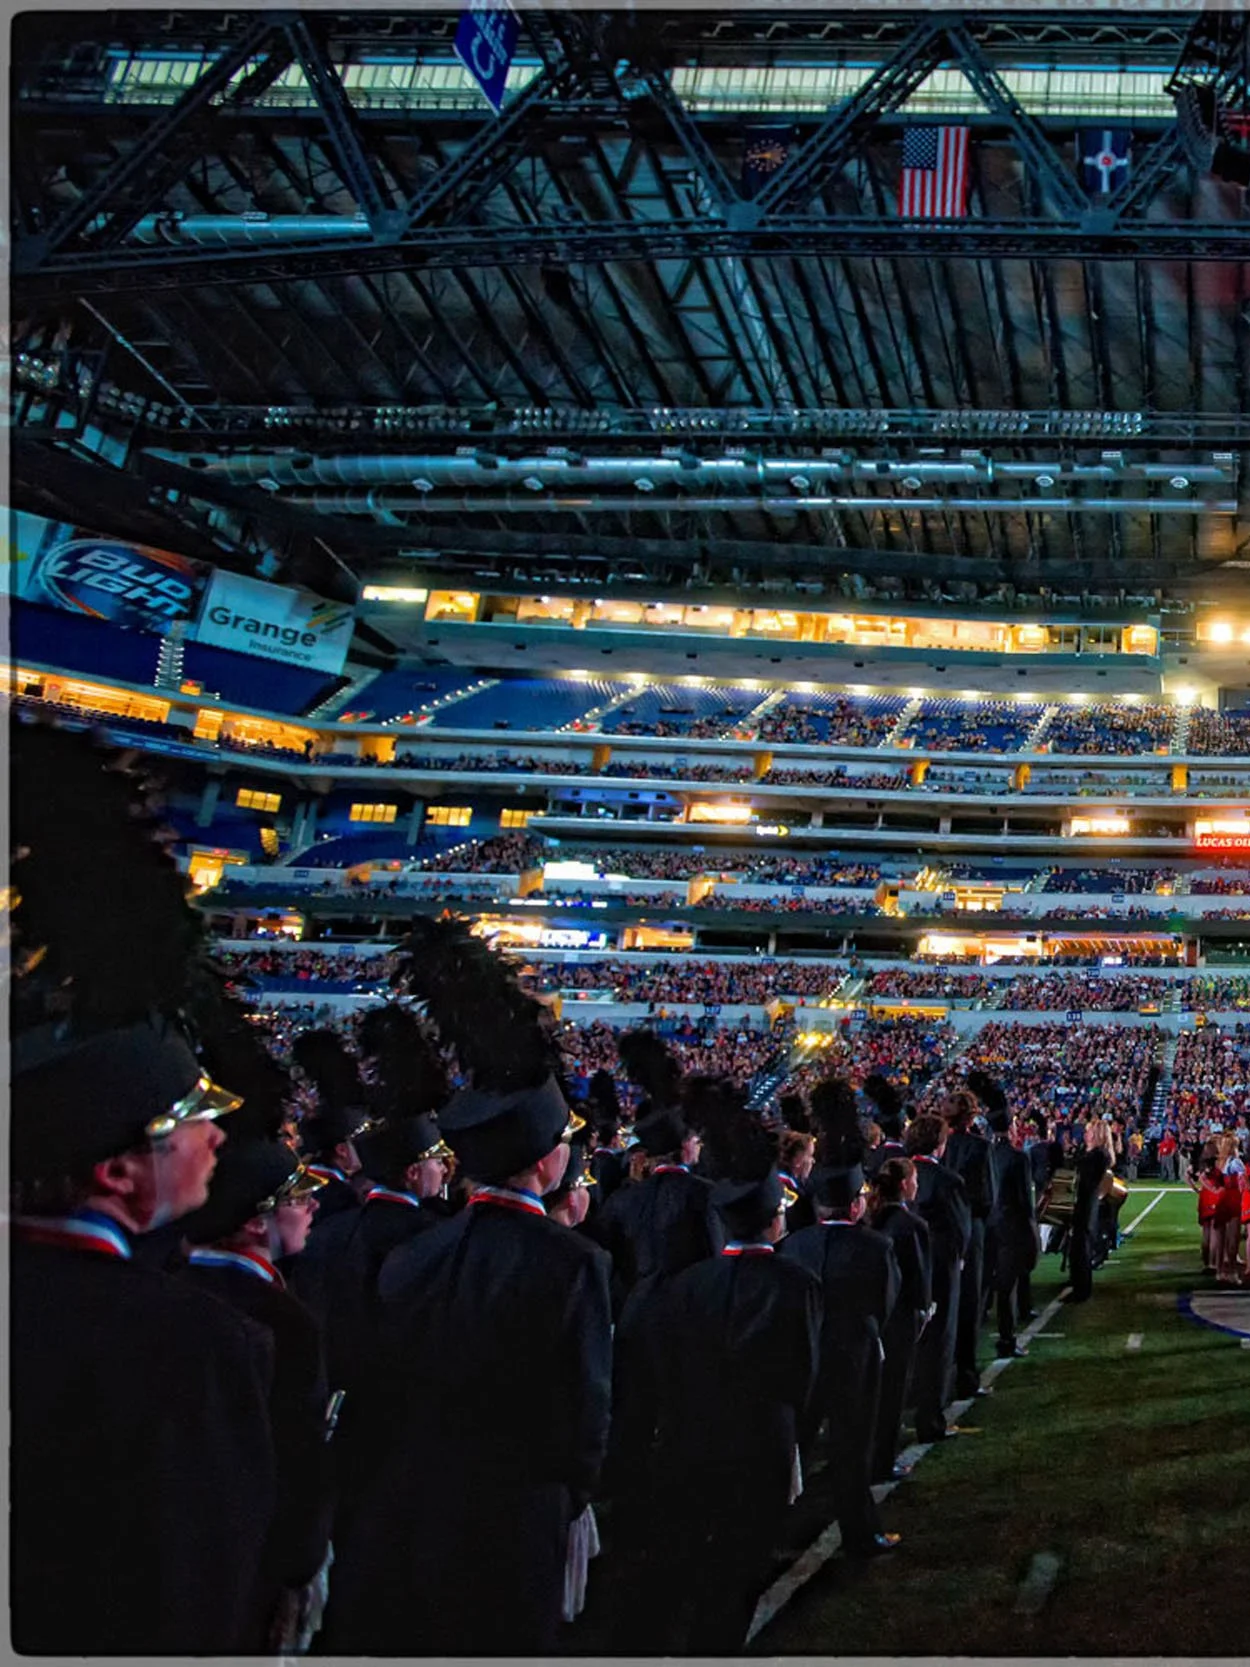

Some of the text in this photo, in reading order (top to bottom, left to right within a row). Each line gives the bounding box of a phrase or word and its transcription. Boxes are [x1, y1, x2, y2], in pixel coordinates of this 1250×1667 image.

[46, 561, 189, 616] LIGHT
[77, 549, 192, 600] BUD
[208, 605, 317, 647] Grange
[248, 639, 312, 662] Insurance
[1196, 838, 1232, 848] LUCAS
